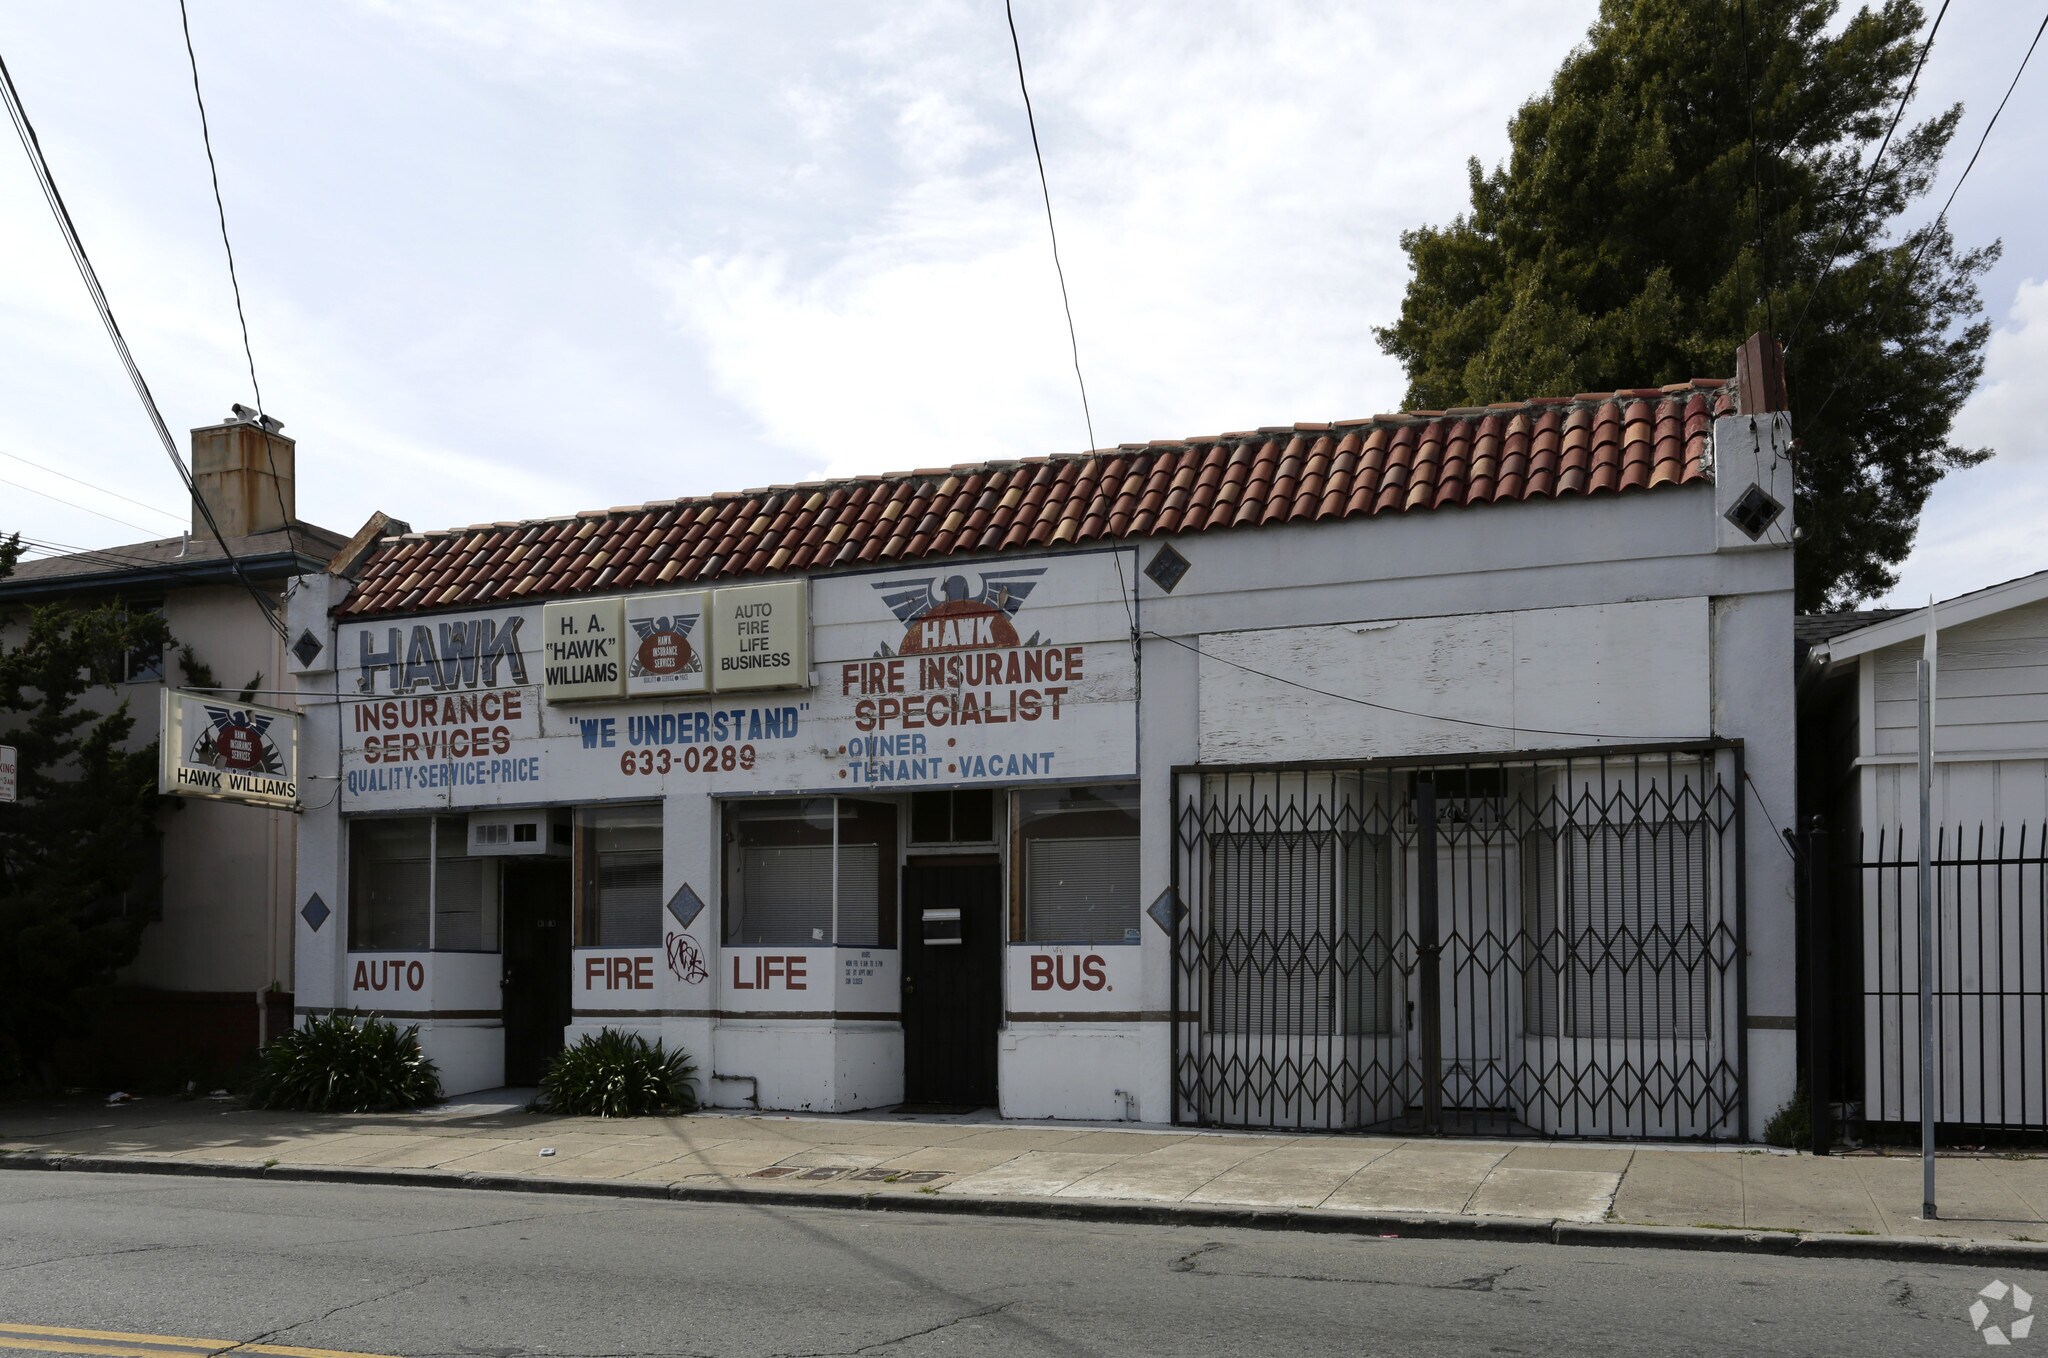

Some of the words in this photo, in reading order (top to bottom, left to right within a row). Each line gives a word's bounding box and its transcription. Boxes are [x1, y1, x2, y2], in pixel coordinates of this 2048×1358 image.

[561, 616, 579, 636] H.
[588, 613, 605, 634] A.
[735, 602, 772, 620] AUTO
[657, 635, 672, 646] HAWK
[738, 619, 769, 636] FIRE
[921, 616, 995, 649] HAWK
[358, 616, 530, 694] HAWK
[653, 645, 678, 657] INSURANCE
[740, 637, 769, 653] LIFE
[545, 662, 618, 687] WILLIAMS
[654, 657, 676, 669] SERVICES
[721, 651, 791, 671] BUSINESS
[842, 661, 905, 696] FIRE
[919, 647, 1083, 691] INSURANCE
[354, 691, 522, 733] INSURANCE
[854, 686, 1069, 732] SPECIALIST
[234, 730, 247, 740] HAWK
[363, 725, 511, 765] SERVICES
[848, 733, 928, 757] OWNER
[620, 744, 757, 777] 633-0289
[848, 757, 943, 784] TENANT
[958, 751, 1055, 779] VACANT
[177, 767, 222, 789] HAWK
[229, 775, 296, 798] WILLIAMS
[352, 960, 425, 992] AUTO
[585, 956, 654, 991] FIRE
[733, 955, 807, 991] LIFE
[1030, 954, 1113, 993] BUS.
